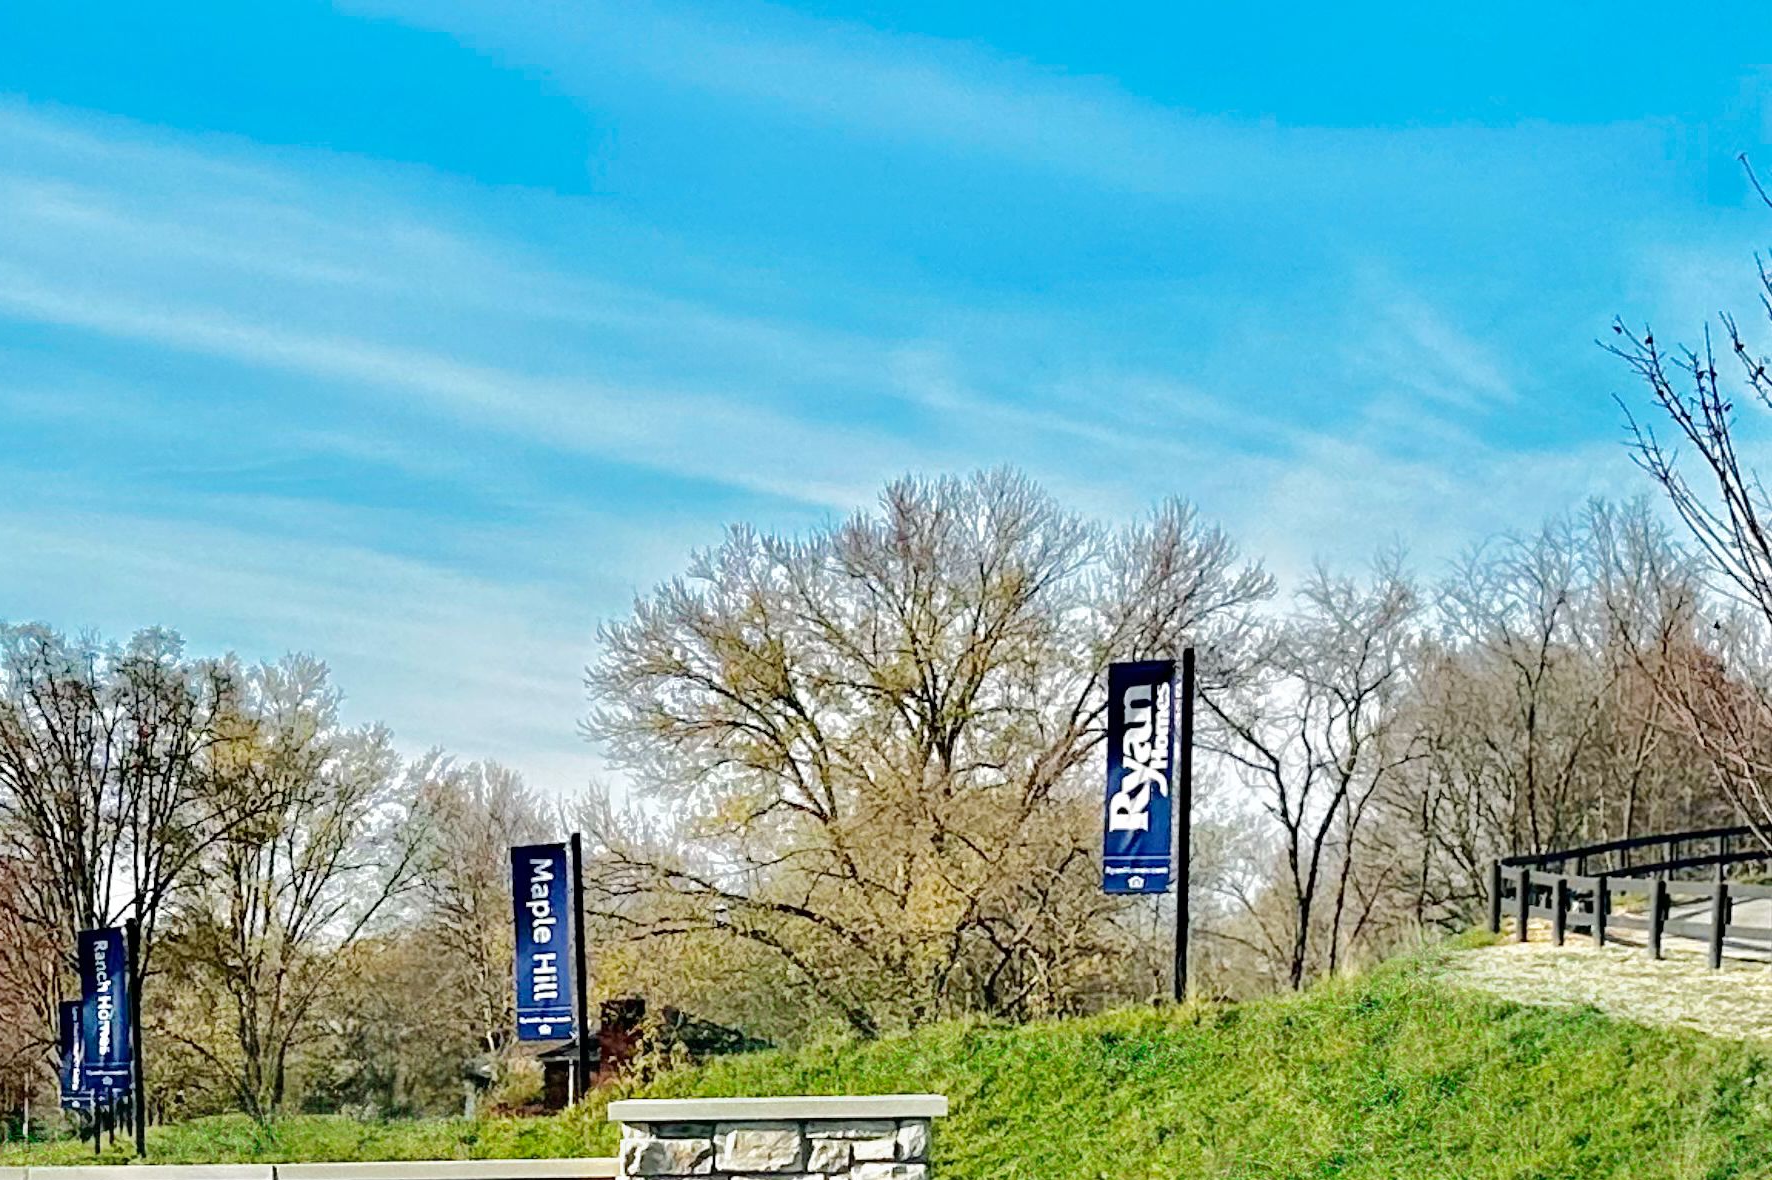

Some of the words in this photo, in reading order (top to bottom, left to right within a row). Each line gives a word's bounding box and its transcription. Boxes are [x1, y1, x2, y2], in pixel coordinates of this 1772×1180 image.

[1109, 684, 1168, 832] Ryan
[1151, 682, 1170, 769] Homes
[526, 858, 557, 944] Maple
[93, 939, 110, 993] Ranch
[533, 952, 558, 1001] Hill
